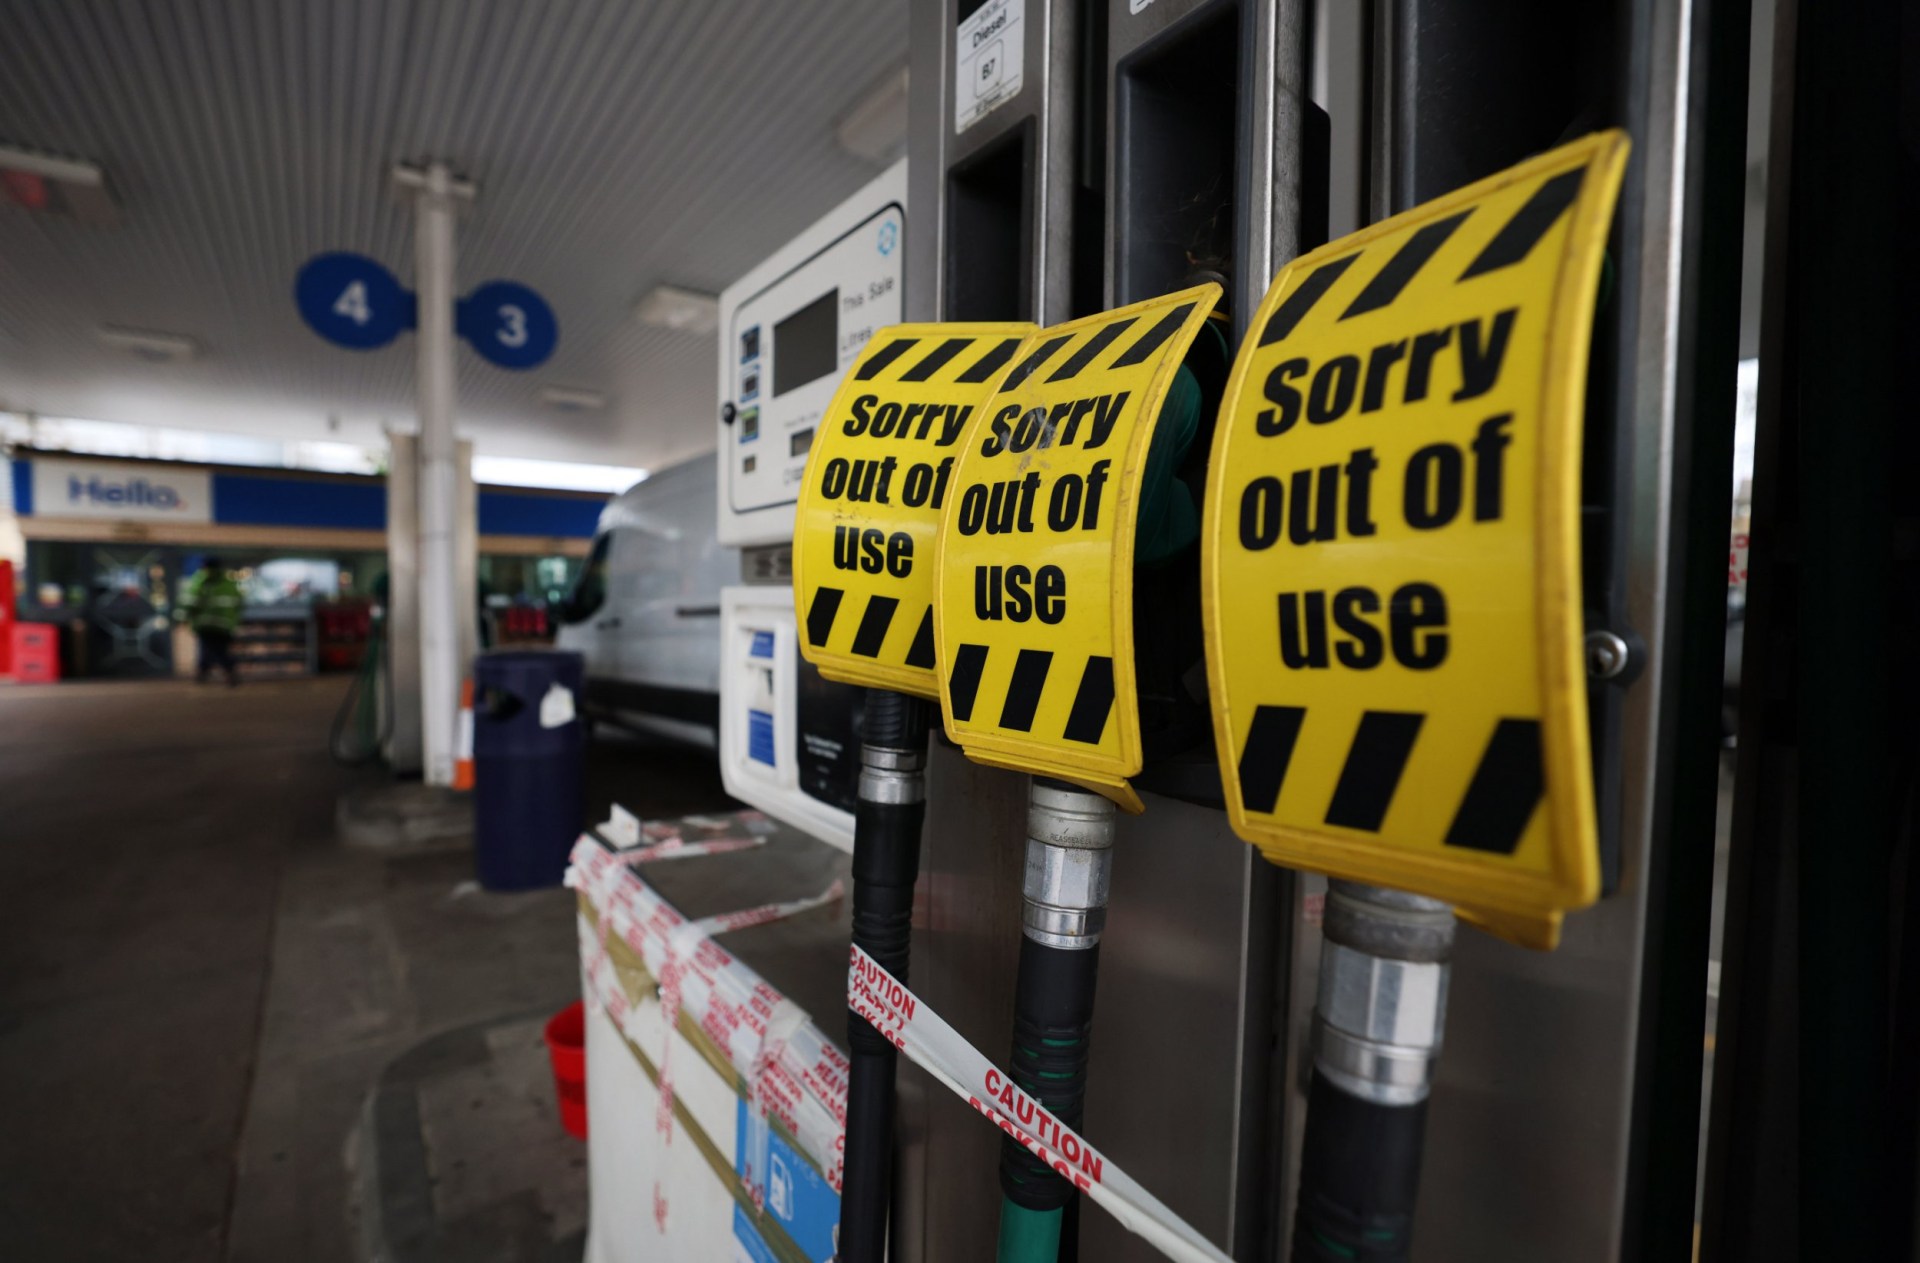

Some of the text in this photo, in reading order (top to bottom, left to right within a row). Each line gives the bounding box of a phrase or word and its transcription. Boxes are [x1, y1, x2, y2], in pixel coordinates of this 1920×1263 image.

[973, 9, 1007, 48] Diesel
[982, 58, 996, 81] B7
[332, 280, 529, 347] 4 3
[868, 277, 896, 301] Sale
[1255, 308, 1518, 438] Sorry
[843, 394, 974, 447] Sorry
[980, 390, 1131, 459] Sorry
[821, 456, 898, 505] out
[958, 459, 1112, 537] out of
[1238, 413, 1514, 552] out of
[833, 526, 914, 579] use
[974, 564, 1067, 625] use
[1277, 581, 1450, 672] use
[849, 946, 917, 1022] CAUTION
[984, 1068, 1104, 1184] CAUTION
